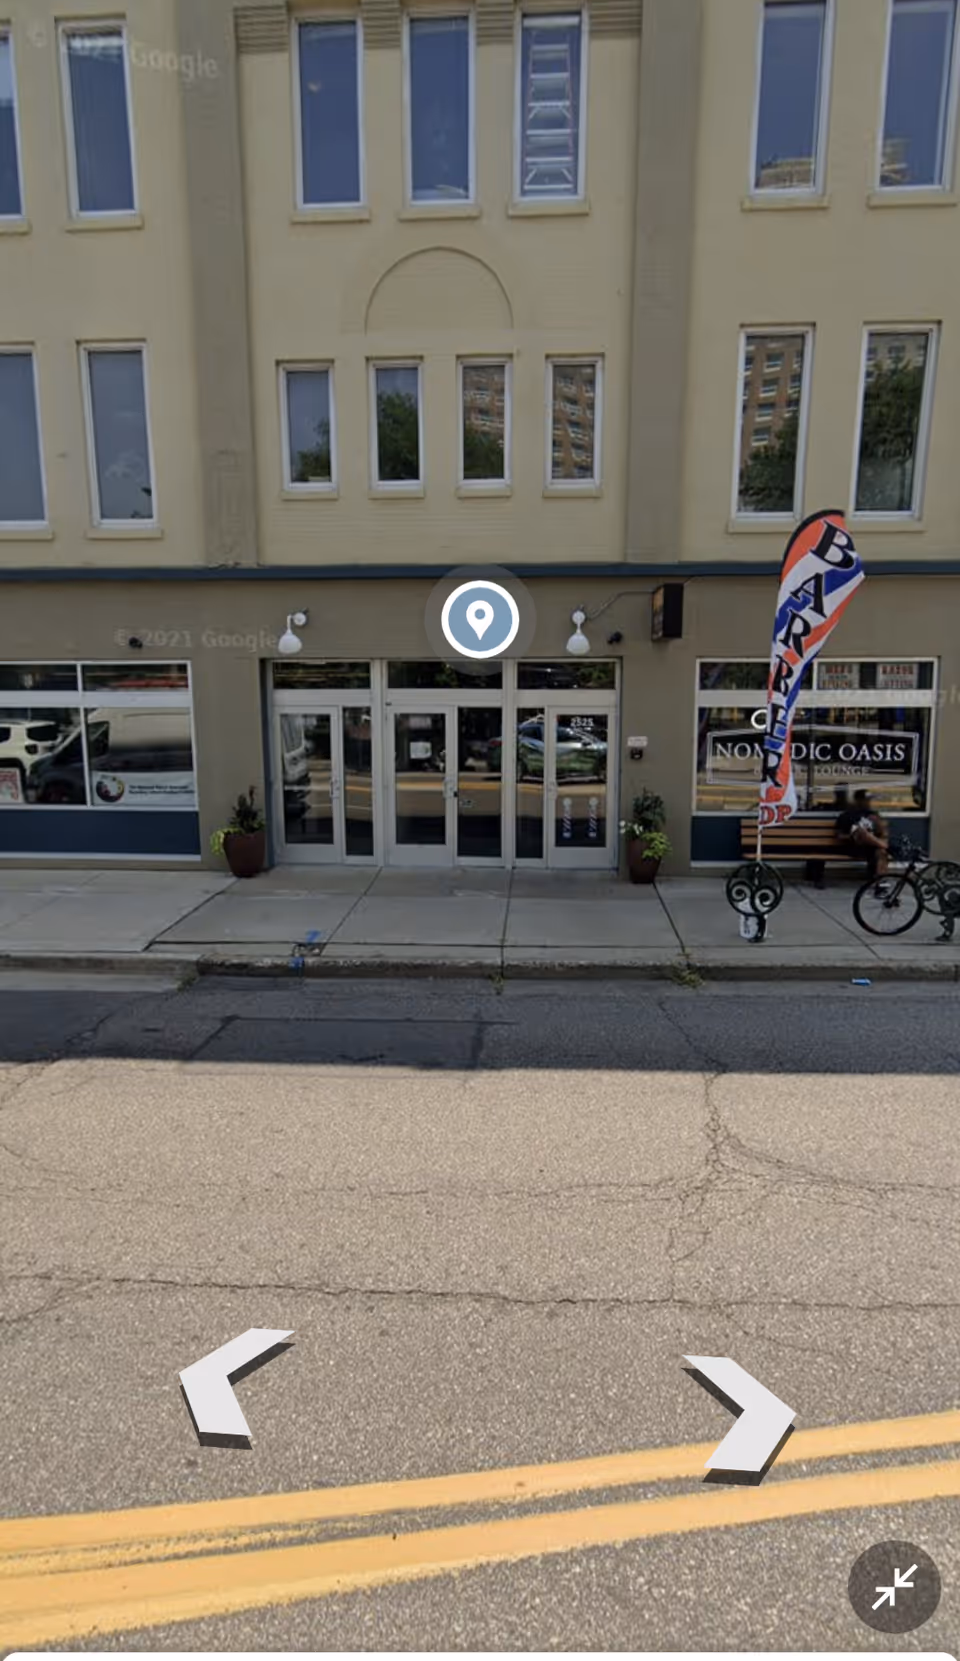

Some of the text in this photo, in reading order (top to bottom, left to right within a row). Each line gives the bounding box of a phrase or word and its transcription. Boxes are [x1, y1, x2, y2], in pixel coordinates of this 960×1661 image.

[761, 519, 856, 788] BARBER
[570, 716, 594, 727] 2525
[715, 742, 906, 761] NODIC OASIS
[813, 765, 870, 777] LOUNGE
